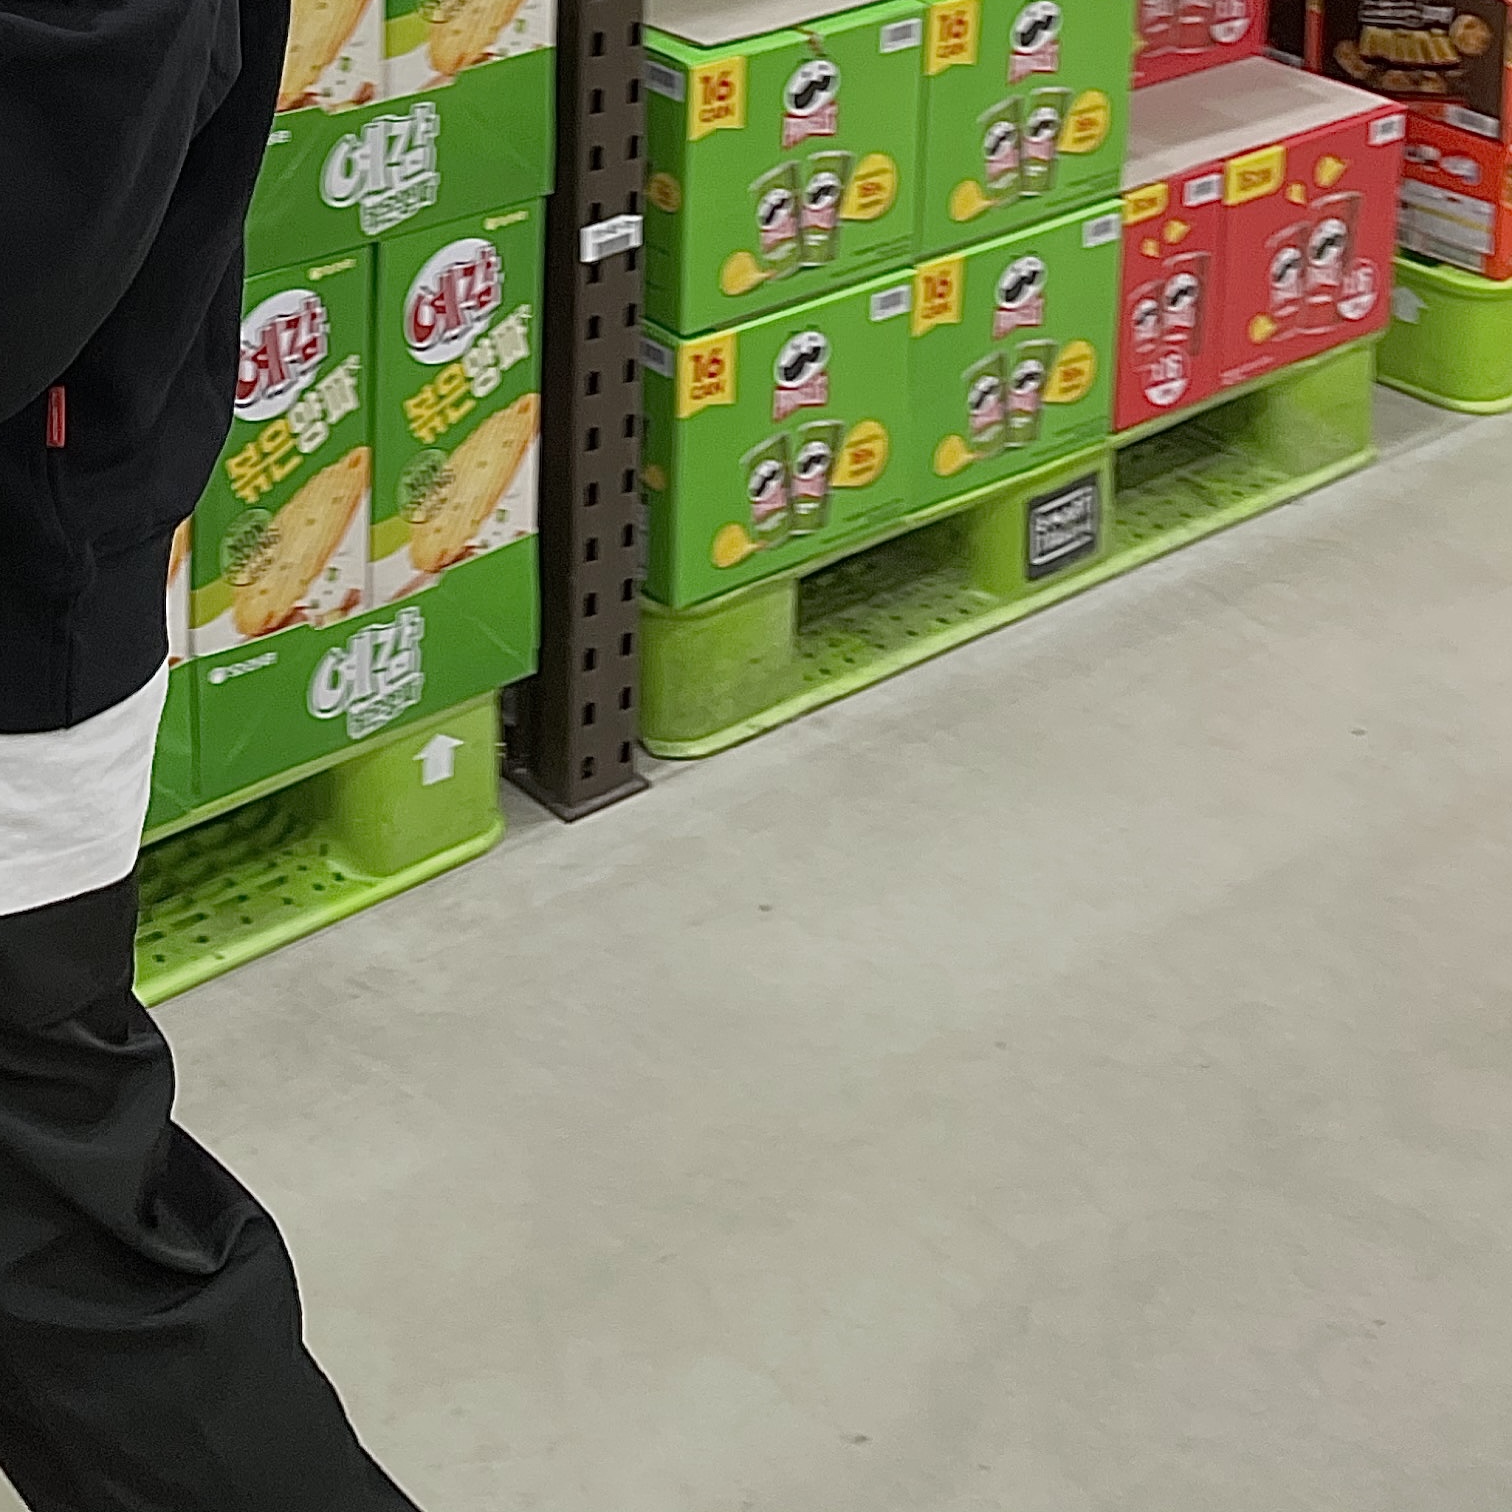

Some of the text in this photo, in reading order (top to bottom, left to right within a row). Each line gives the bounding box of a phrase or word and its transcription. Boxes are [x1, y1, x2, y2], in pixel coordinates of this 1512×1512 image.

[320, 101, 440, 208] 예감
[406, 242, 506, 355] 예감
[308, 607, 426, 721] 예감
